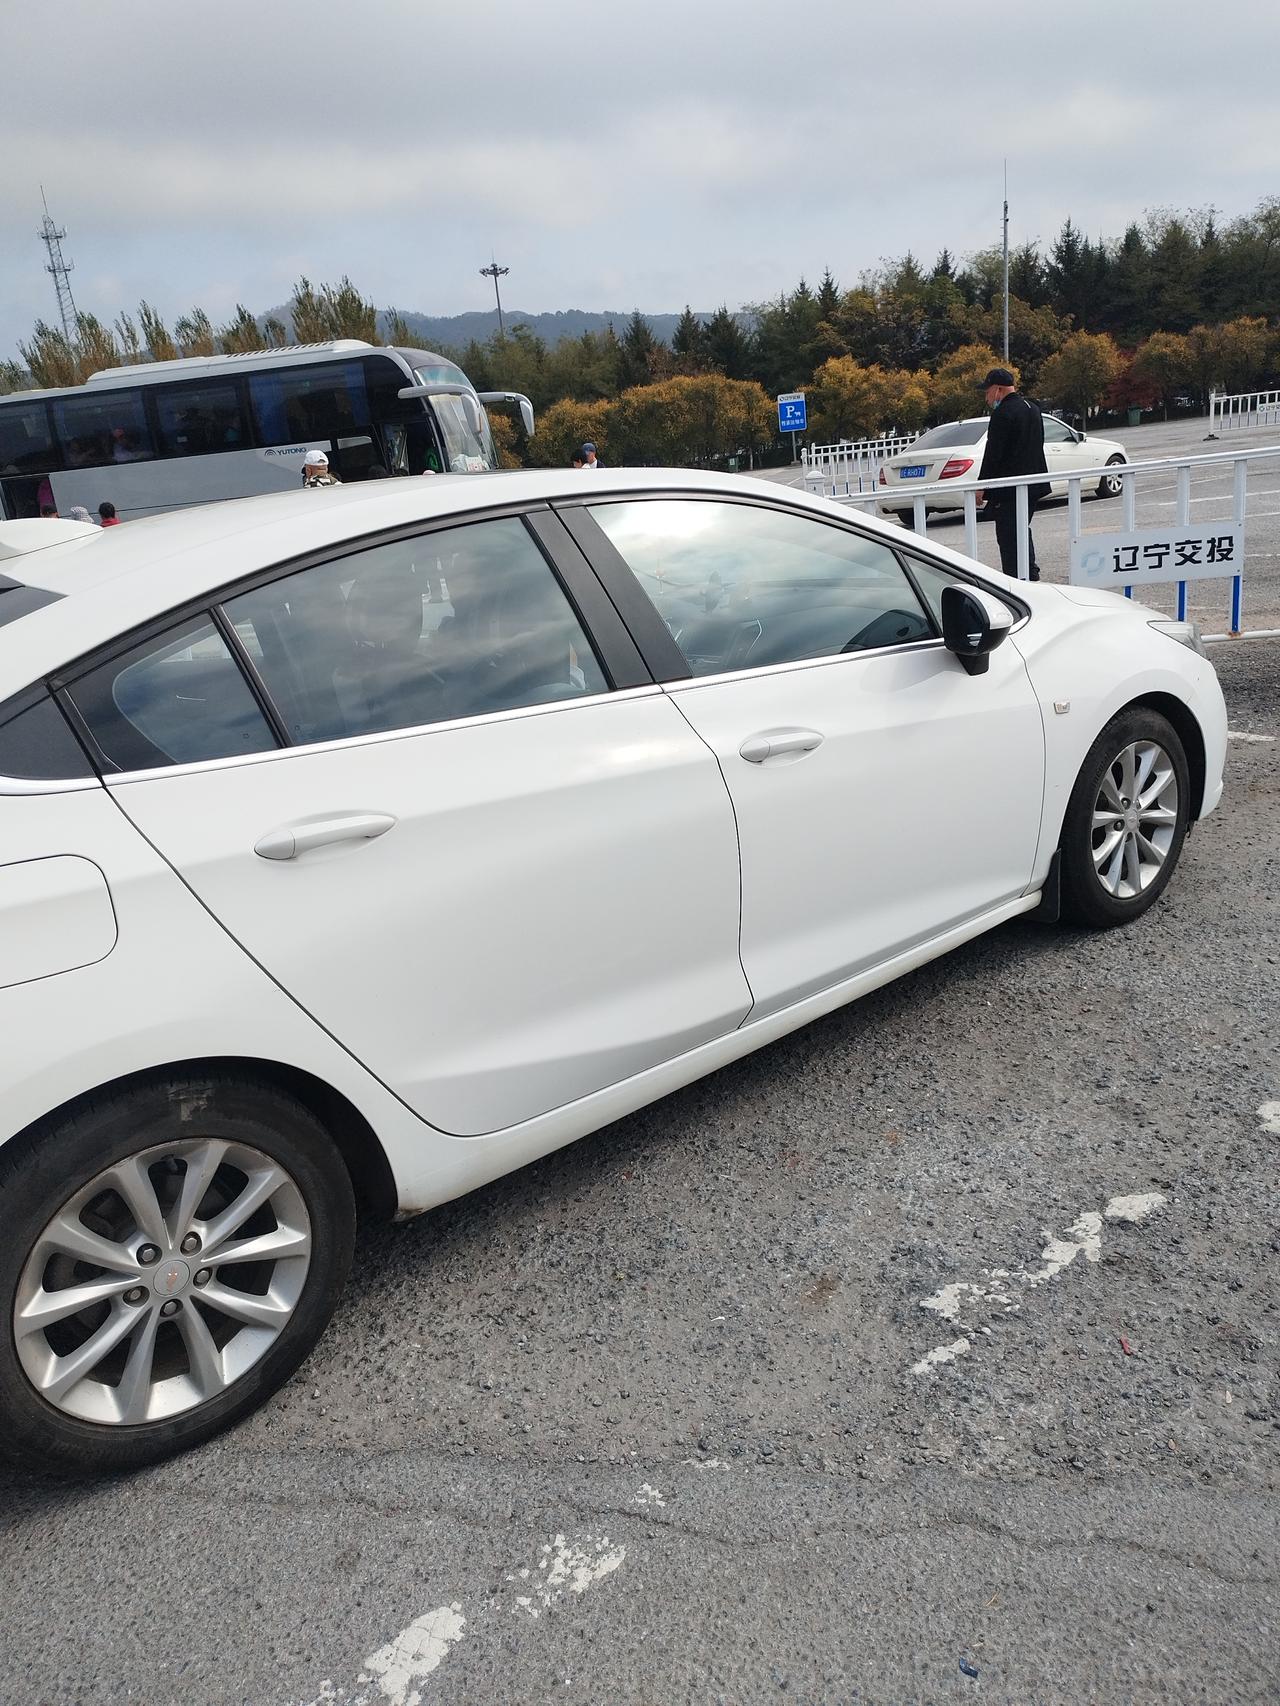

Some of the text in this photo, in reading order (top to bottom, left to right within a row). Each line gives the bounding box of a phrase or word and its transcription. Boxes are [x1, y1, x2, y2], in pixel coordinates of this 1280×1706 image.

[785, 405, 795, 418] P
[277, 446, 307, 456] YUTONG
[1112, 535, 1234, 572] 辽宁交投
